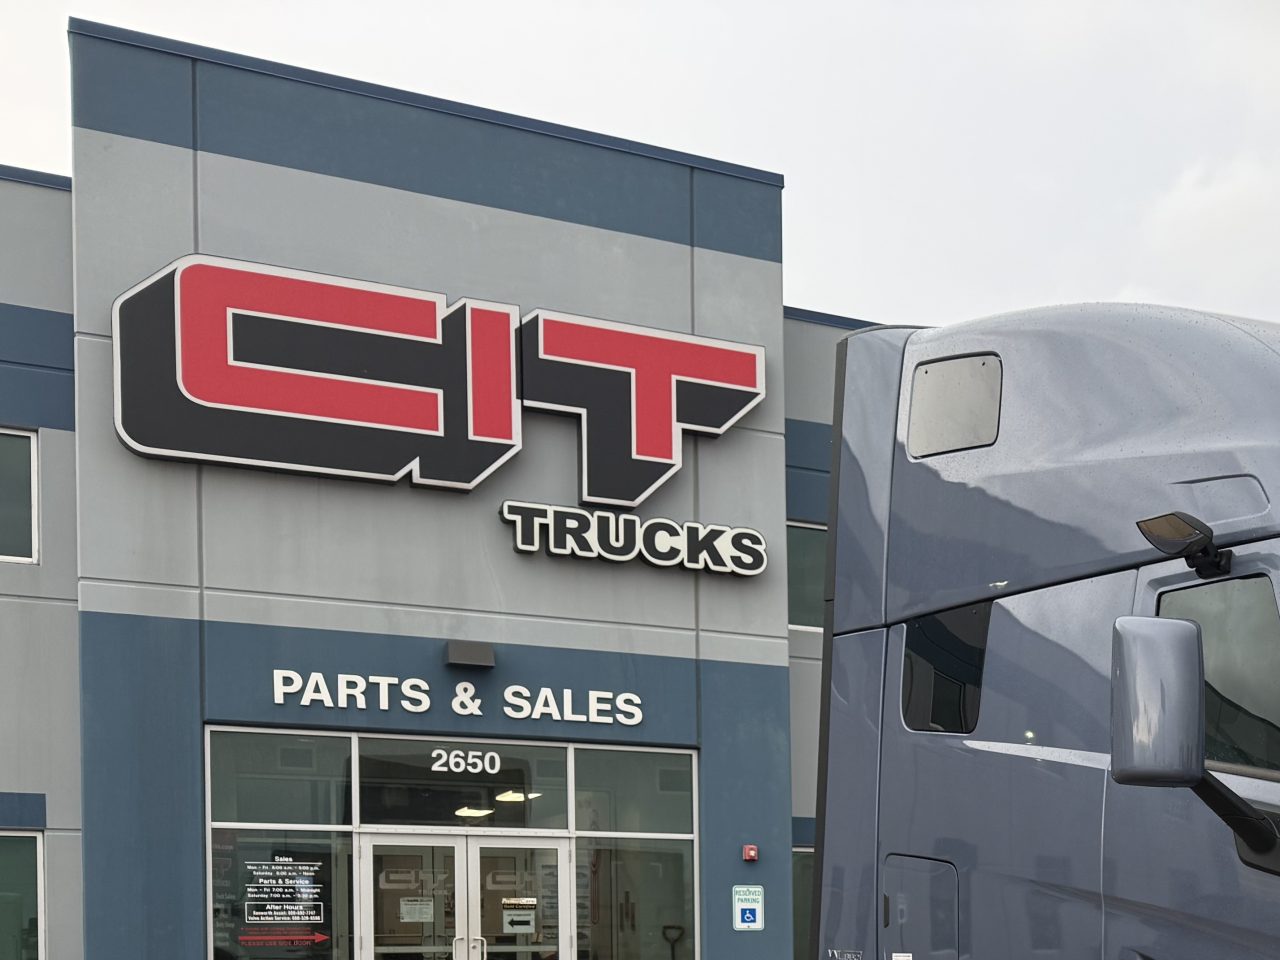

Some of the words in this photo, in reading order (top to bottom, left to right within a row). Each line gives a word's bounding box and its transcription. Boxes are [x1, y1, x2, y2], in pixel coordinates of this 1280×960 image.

[112, 254, 766, 506] CIT
[502, 500, 768, 576] TRUCKS
[272, 669, 432, 713] PARTS
[451, 681, 483, 716] &
[503, 684, 643, 726] SALES
[431, 749, 501, 774] 2650
